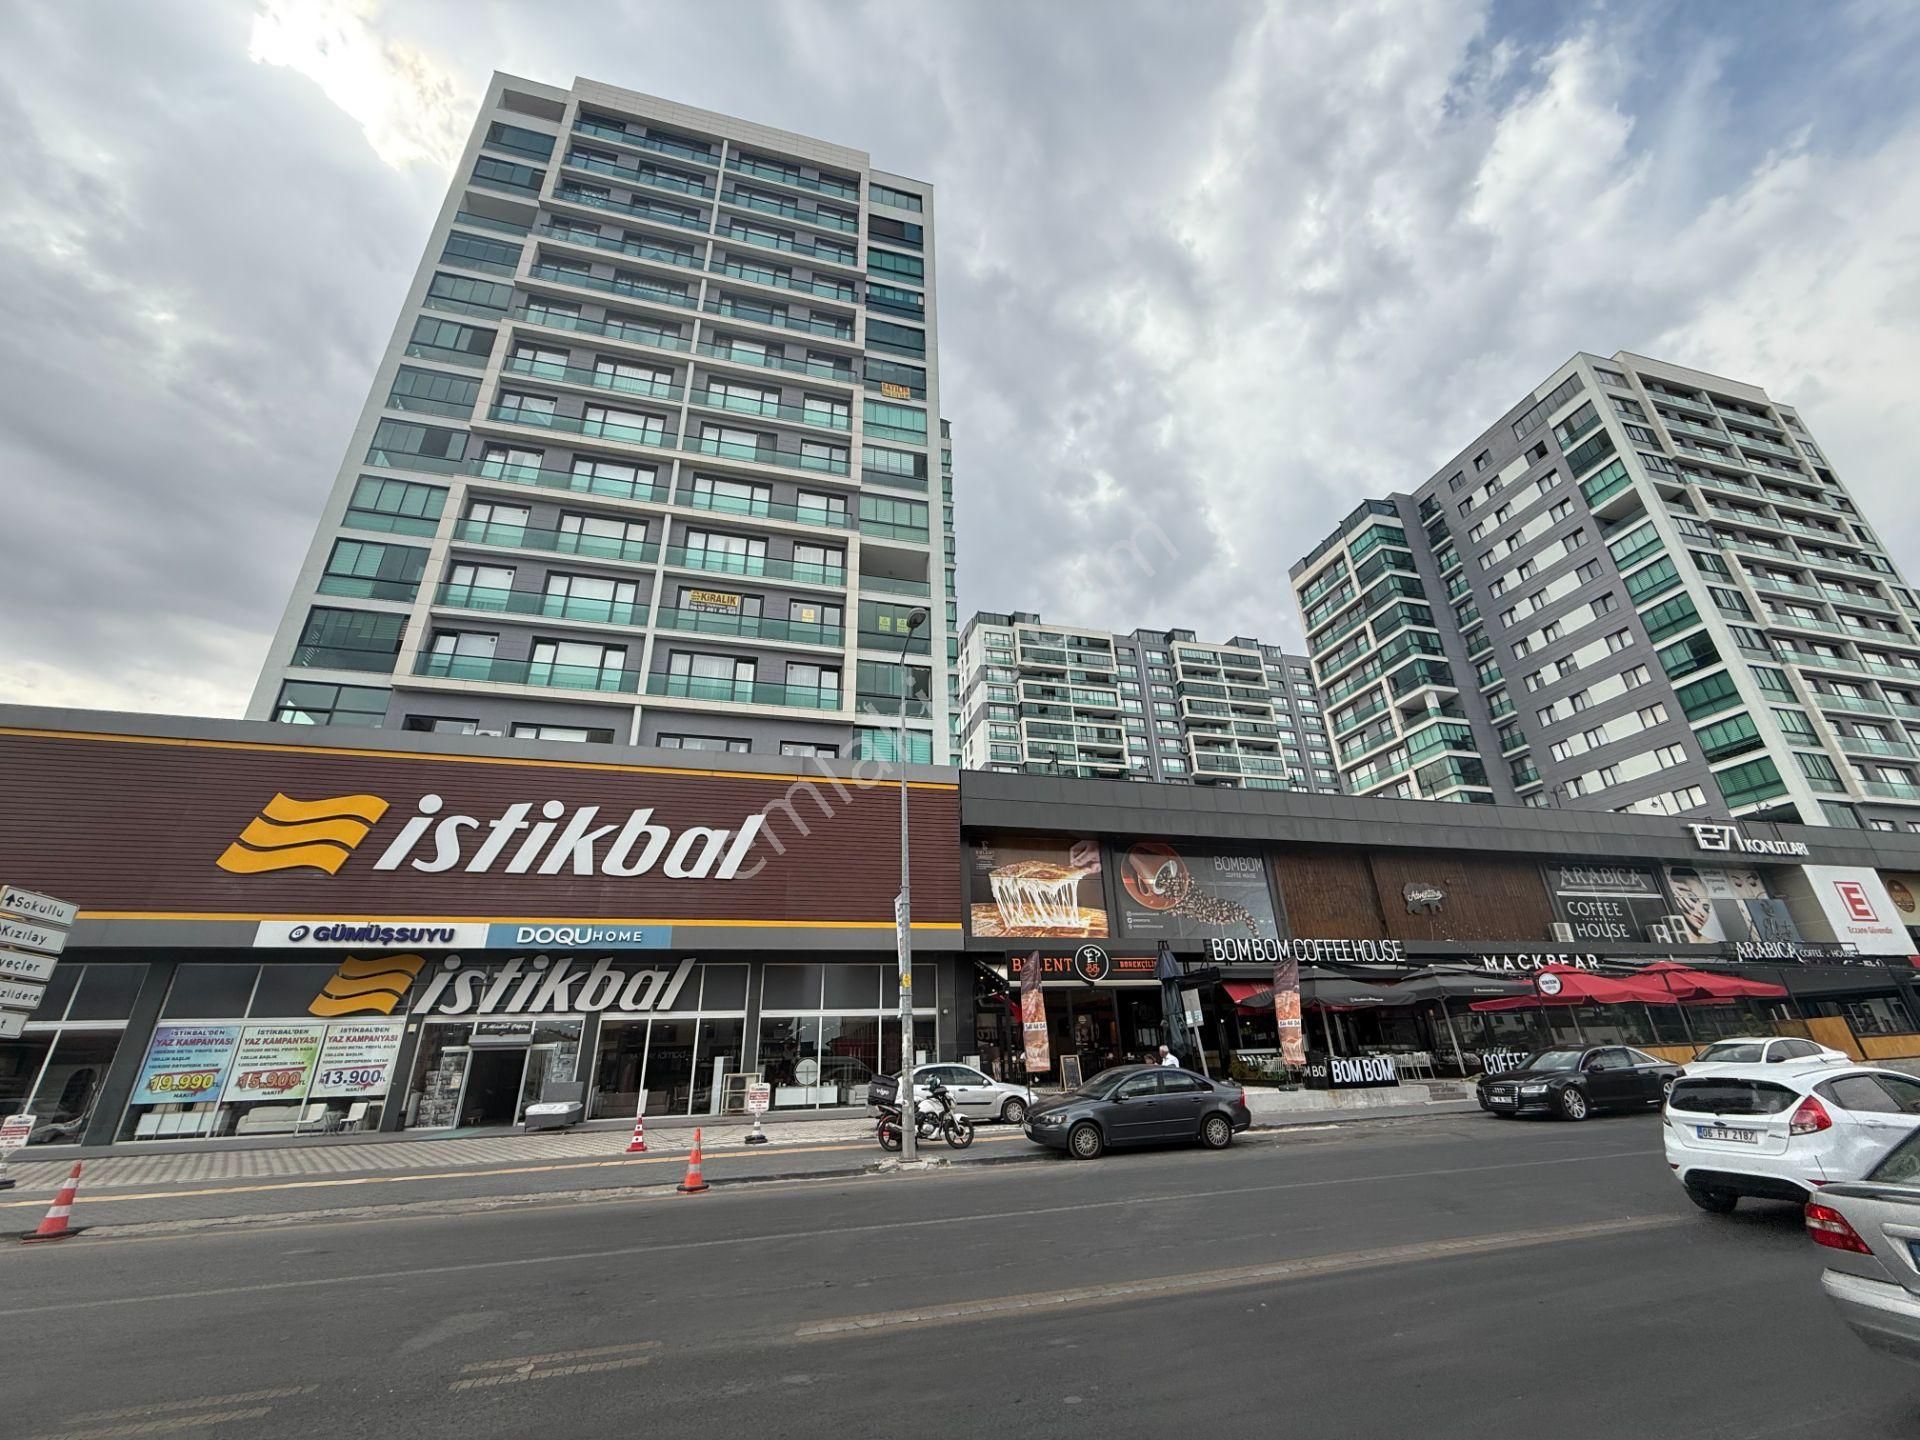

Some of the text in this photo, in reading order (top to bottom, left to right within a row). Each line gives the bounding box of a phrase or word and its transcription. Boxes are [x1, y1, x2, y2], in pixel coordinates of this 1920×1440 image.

[372, 794, 767, 880] istikbal
[1744, 838, 1810, 856] KONUTLARI
[1560, 866, 1648, 891] ARABICA
[15, 896, 65, 918] Sokullu
[1567, 901, 1623, 917] COFFEE
[1, 925, 48, 946] Kızılay
[313, 923, 455, 946] GÜMÜŞSUYU
[1575, 922, 1631, 938] HOUSE
[1292, 939, 1353, 962] COFFEE
[1352, 940, 1406, 962] HOUSE
[1735, 941, 1805, 964] ARABICA
[1012, 957, 1073, 972] BENT
[1483, 953, 1600, 971] MACKBEAR
[411, 954, 697, 1015] istikbal
[156, 1037, 234, 1047] YAZ KAMPANYASI
[244, 1036, 318, 1046] YAZ KAMPANYASI
[328, 1034, 399, 1043] YAZ KAMPANYASI
[150, 1073, 215, 1092] 19.990
[237, 1071, 302, 1089] 15.900
[323, 1069, 382, 1085] 13.900
[1717, 1129, 1728, 1139] FV
[1732, 1130, 1755, 1141] 2187
